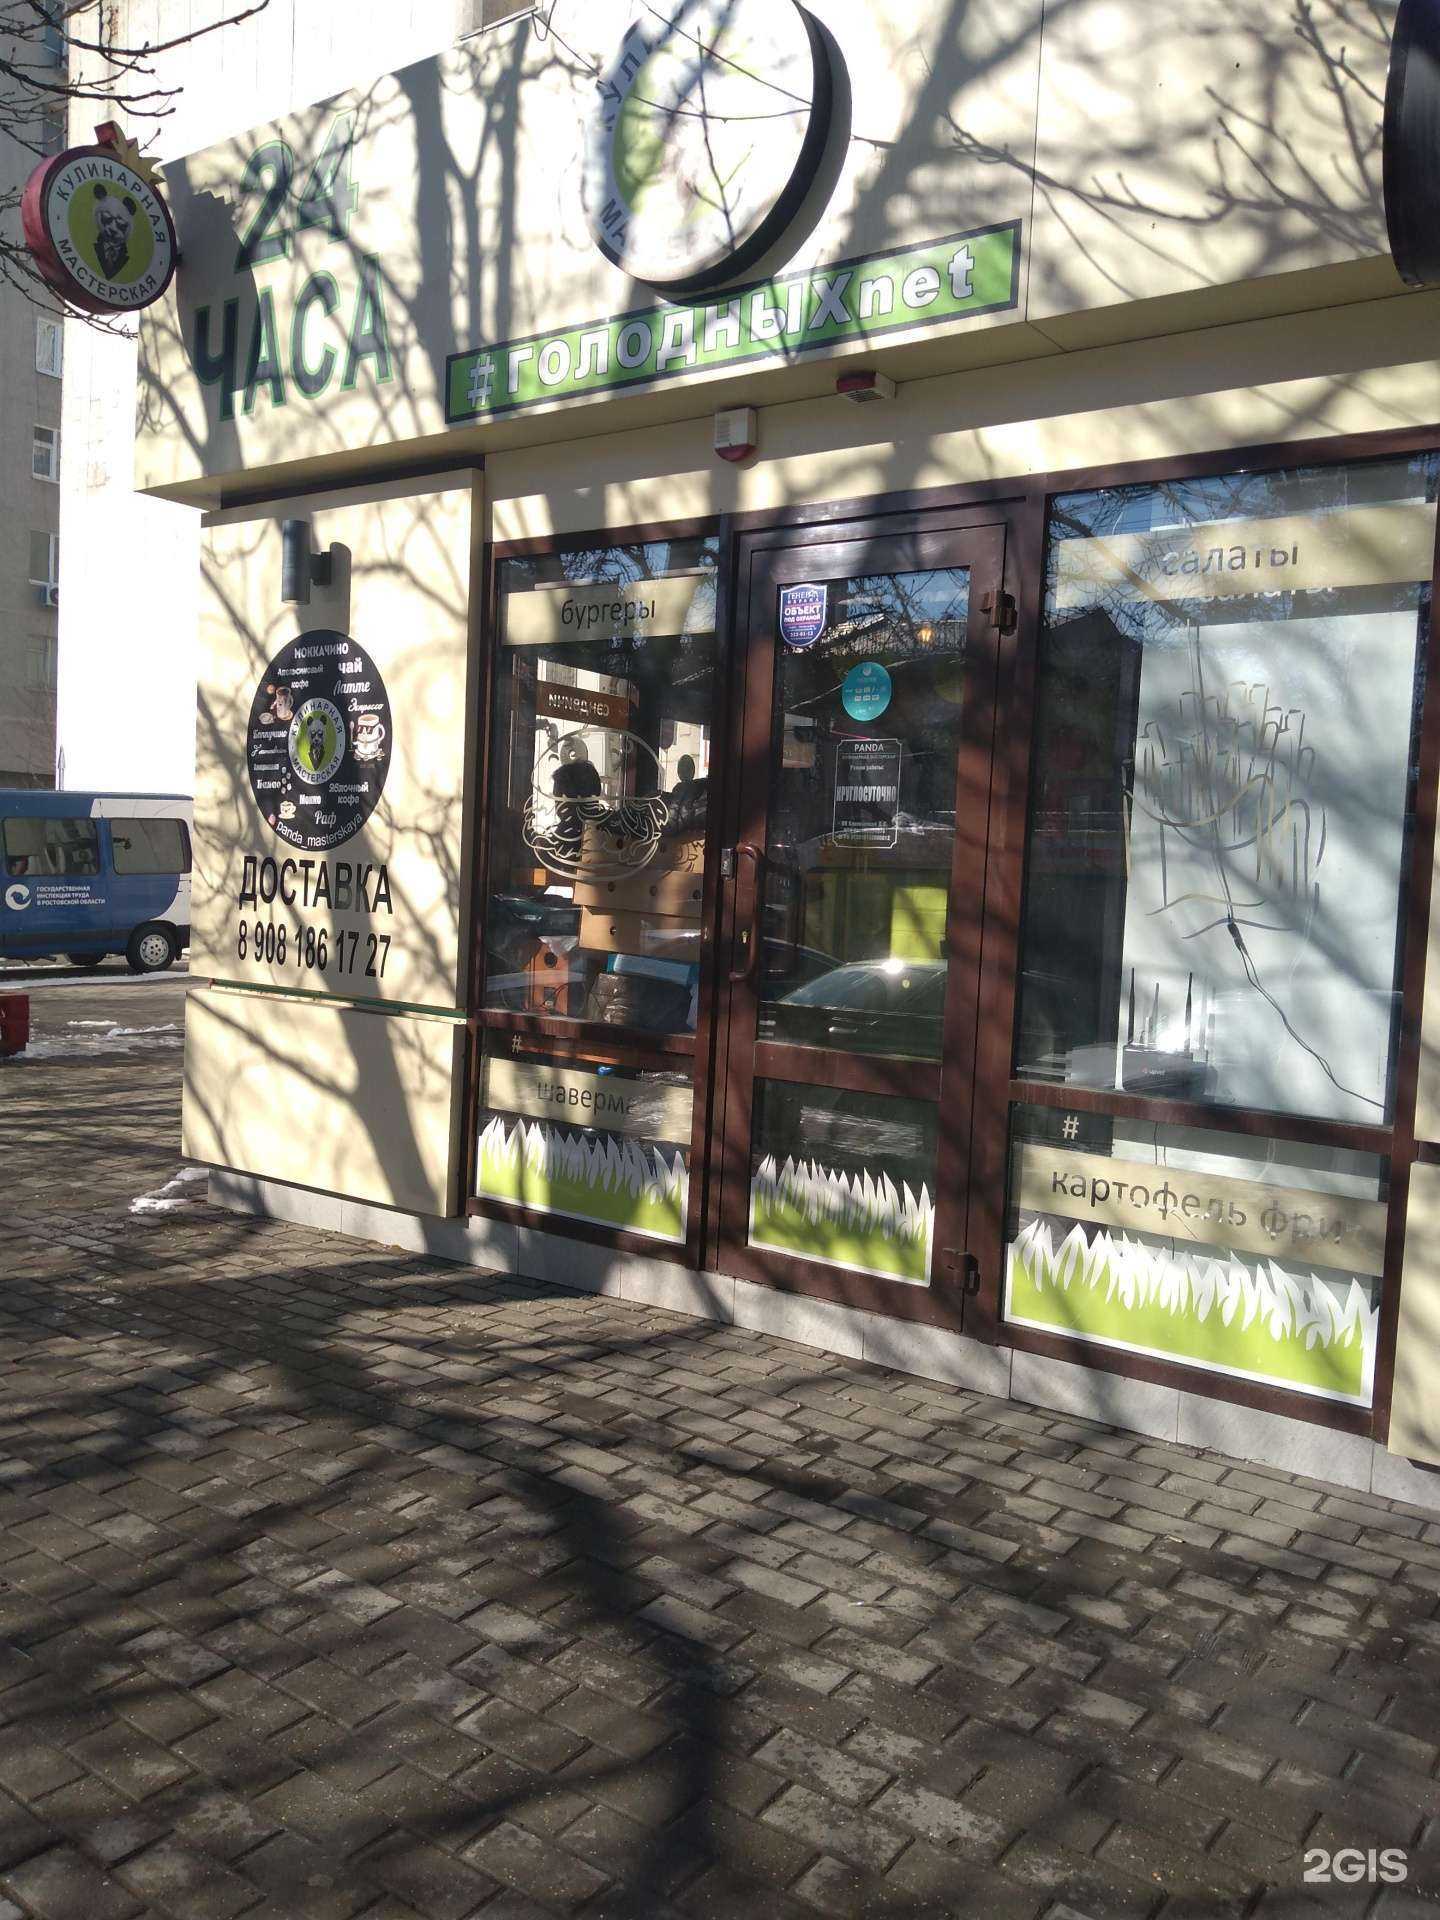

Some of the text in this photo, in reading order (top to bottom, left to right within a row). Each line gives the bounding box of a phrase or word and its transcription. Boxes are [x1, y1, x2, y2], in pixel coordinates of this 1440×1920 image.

[56, 163, 166, 243] КУЛИНАРНАЯ
[234, 106, 359, 273] 24
[58, 239, 157, 301] МАСТЕРСКАЯ
[194, 252, 394, 421] ЧАСА
[560, 599, 656, 629] бургеры
[784, 605, 821, 616] ОБЪЕКТ
[294, 643, 349, 659] МОККАЧИНО
[337, 657, 363, 674] чай
[854, 744, 885, 752] PANDA
[836, 786, 897, 802] КРУГЛОСУТОЧНО
[276, 813, 363, 849] panda_masterskaya
[314, 810, 337, 829] Раф
[239, 856, 393, 915] ДОСТАВКА
[238, 919, 392, 978] 8 908 186 17 27
[1051, 1170, 1248, 1226] картофель
